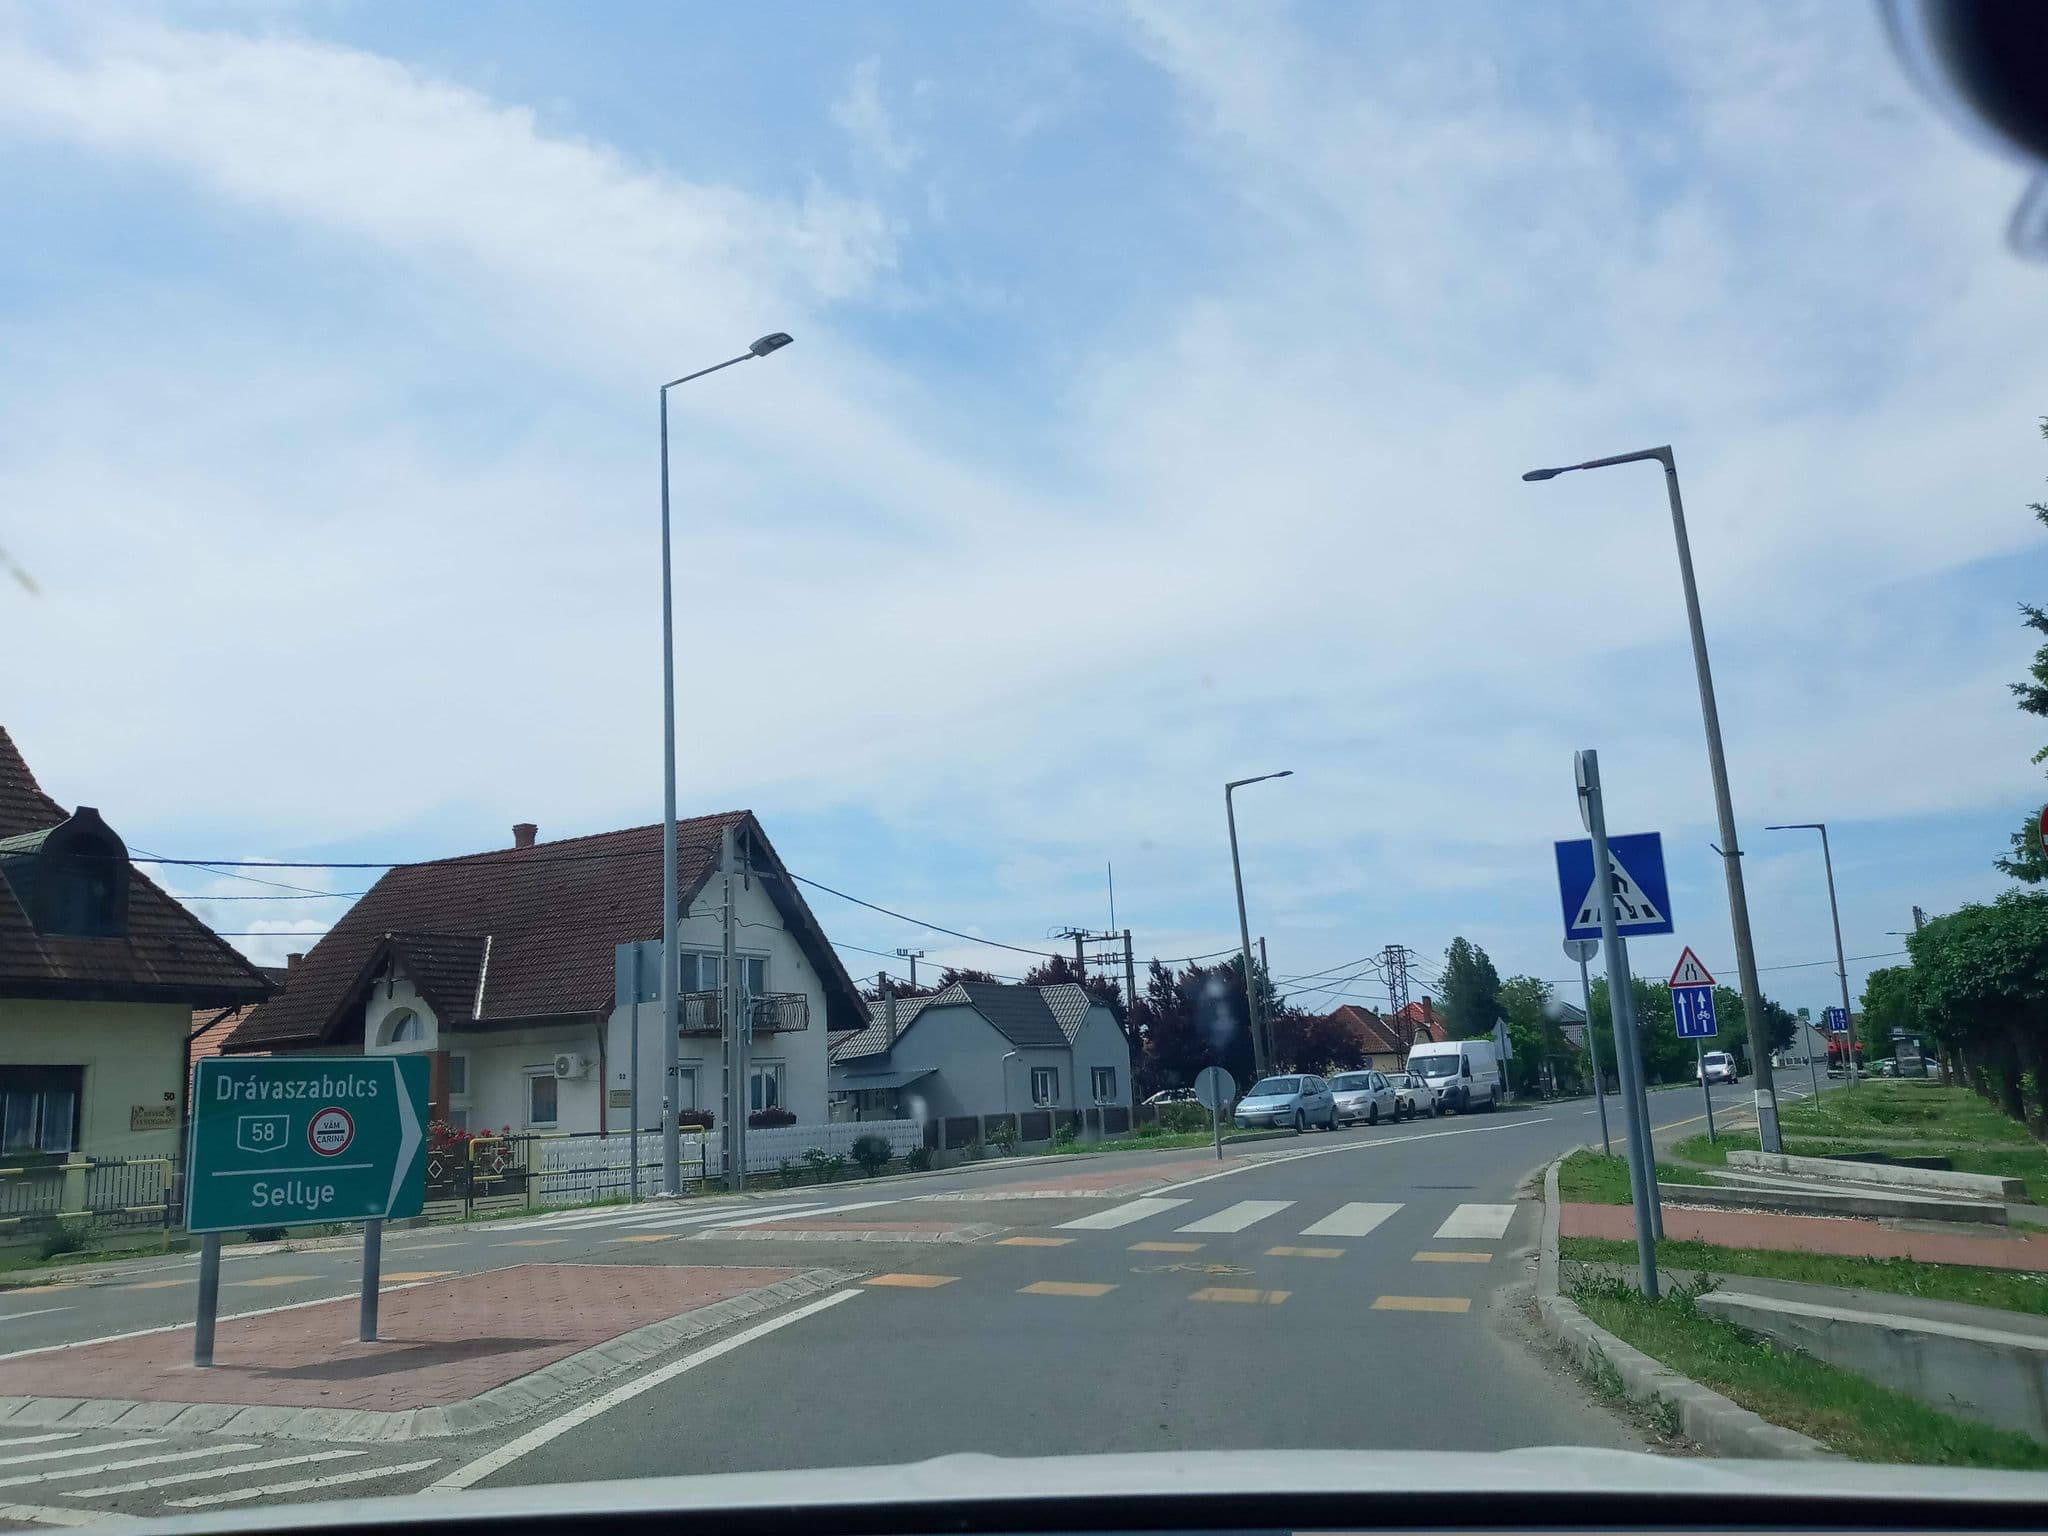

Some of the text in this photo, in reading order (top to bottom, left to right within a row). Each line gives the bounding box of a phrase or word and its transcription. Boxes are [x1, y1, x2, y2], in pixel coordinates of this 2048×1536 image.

[216, 1074, 378, 1100] Drávaszabolcs
[164, 1092, 175, 1101] 50
[323, 1120, 340, 1129] VÁM
[252, 1123, 274, 1141] 58
[316, 1135, 345, 1144] CARINA
[251, 1181, 335, 1210] Sellye
